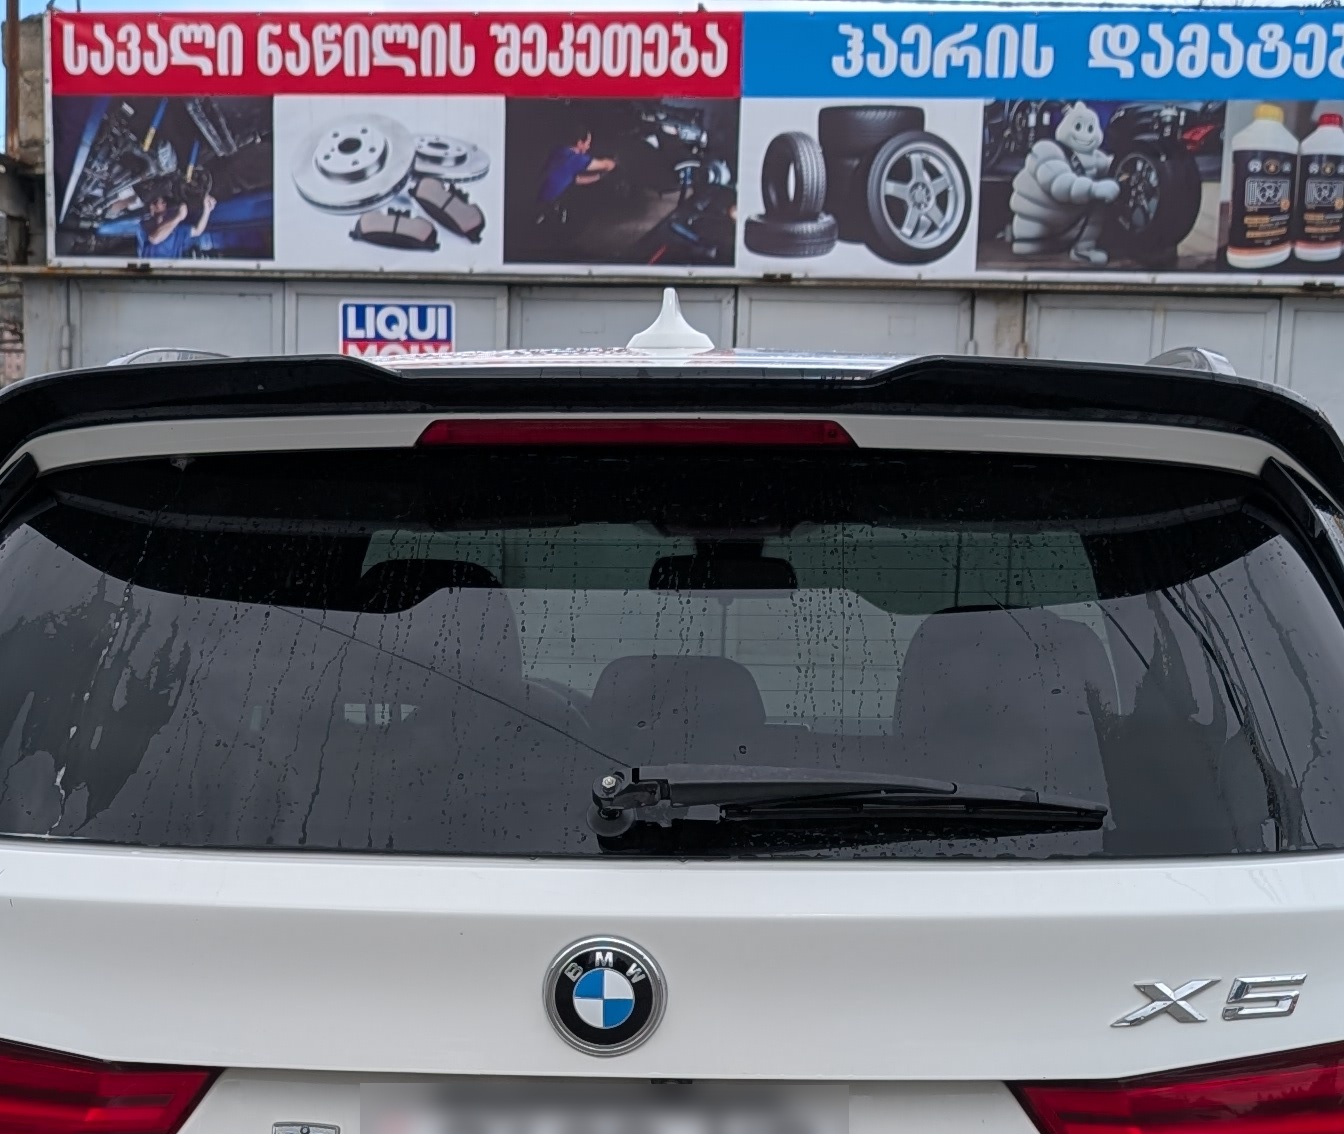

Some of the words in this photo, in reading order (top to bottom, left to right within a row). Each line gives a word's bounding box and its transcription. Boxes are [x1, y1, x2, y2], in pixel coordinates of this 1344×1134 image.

[62, 22, 244, 77] სავალი
[257, 22, 476, 78] ნაწილის
[489, 22, 729, 78] შეკეთება
[831, 23, 1055, 79] ჰაერის
[347, 306, 448, 341] LIQUI
[564, 951, 646, 984] BMW
[1110, 972, 1308, 1028] X5
